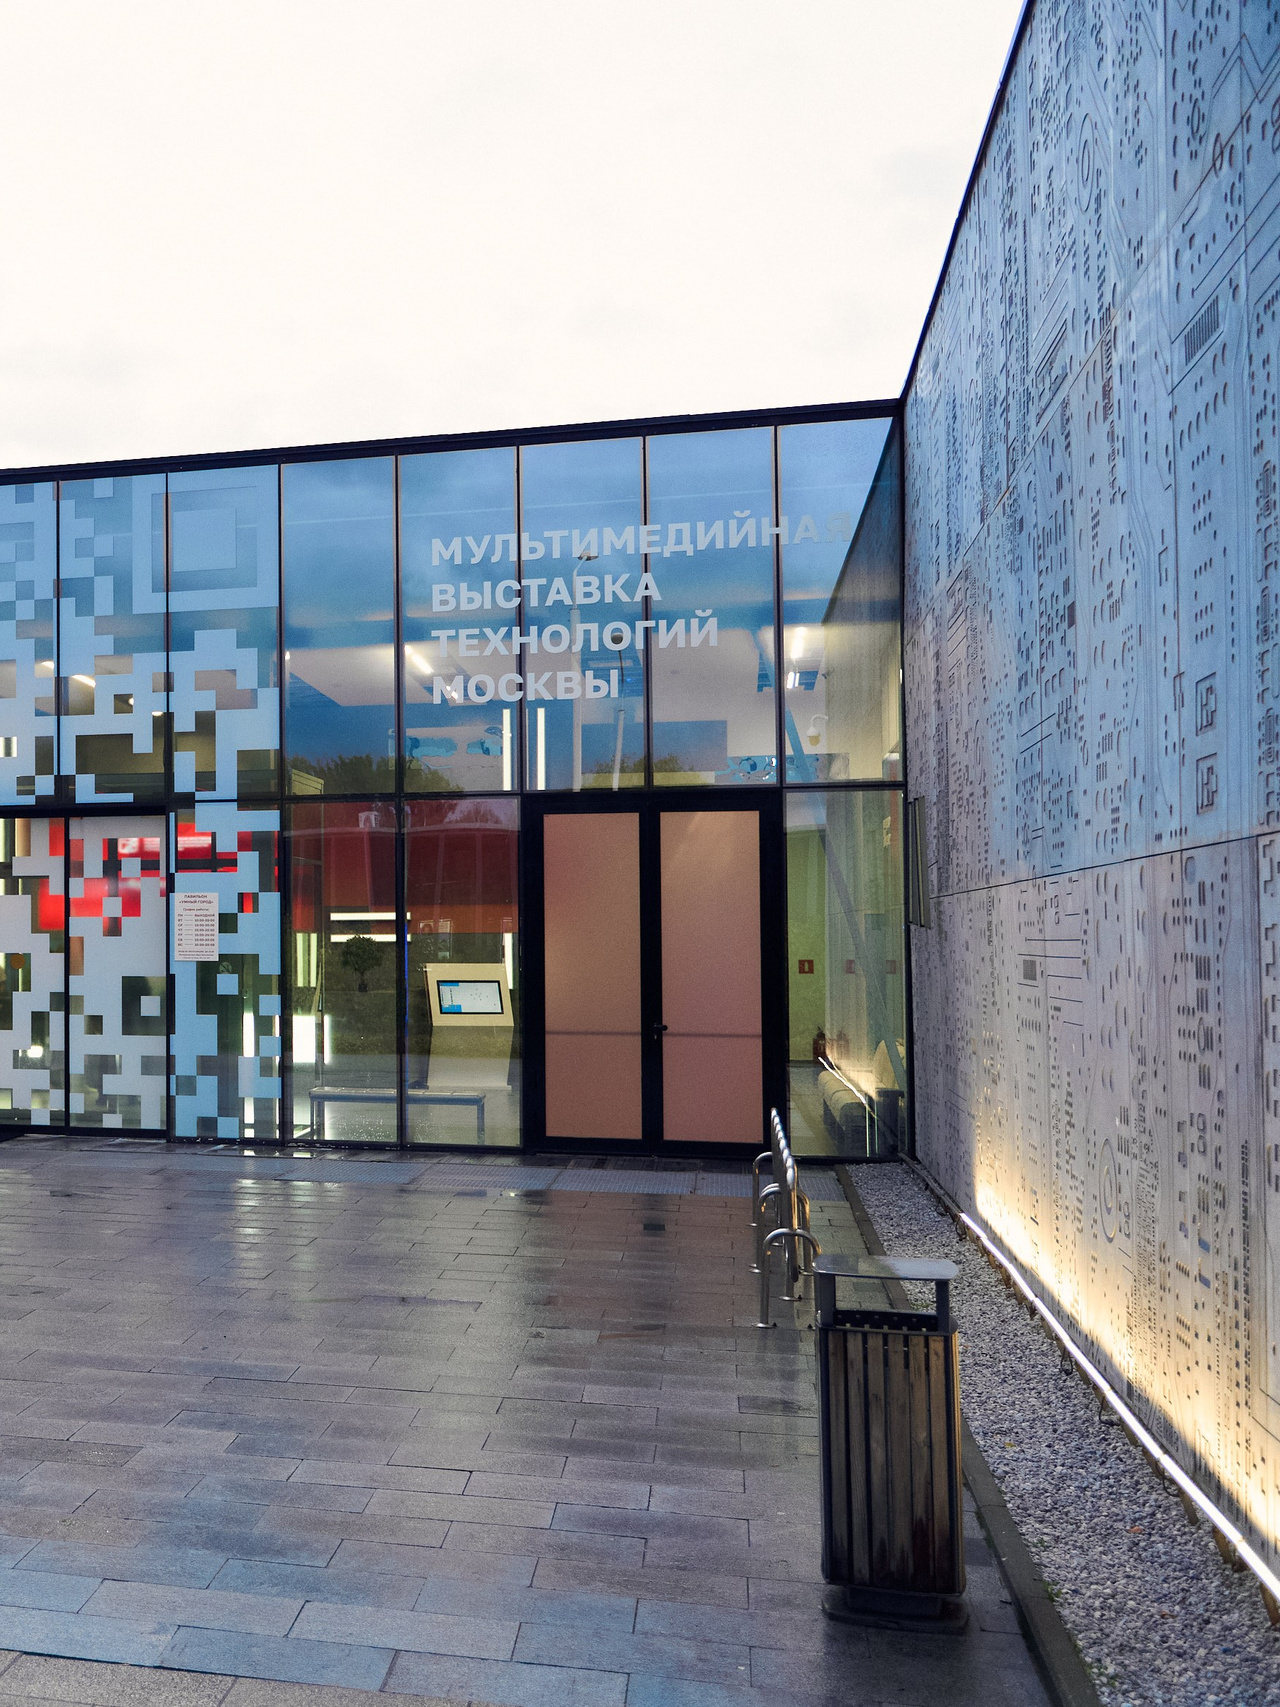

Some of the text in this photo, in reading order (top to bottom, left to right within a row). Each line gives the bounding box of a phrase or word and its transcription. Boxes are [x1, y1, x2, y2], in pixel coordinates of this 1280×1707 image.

[431, 510, 852, 567] МУЛЬТИМЕДИЙНАЯ
[431, 572, 662, 613] ВЫСТАВКА
[431, 609, 718, 659] ТЕХНОЛОГИЙ
[432, 669, 619, 705] МОСКВЫ
